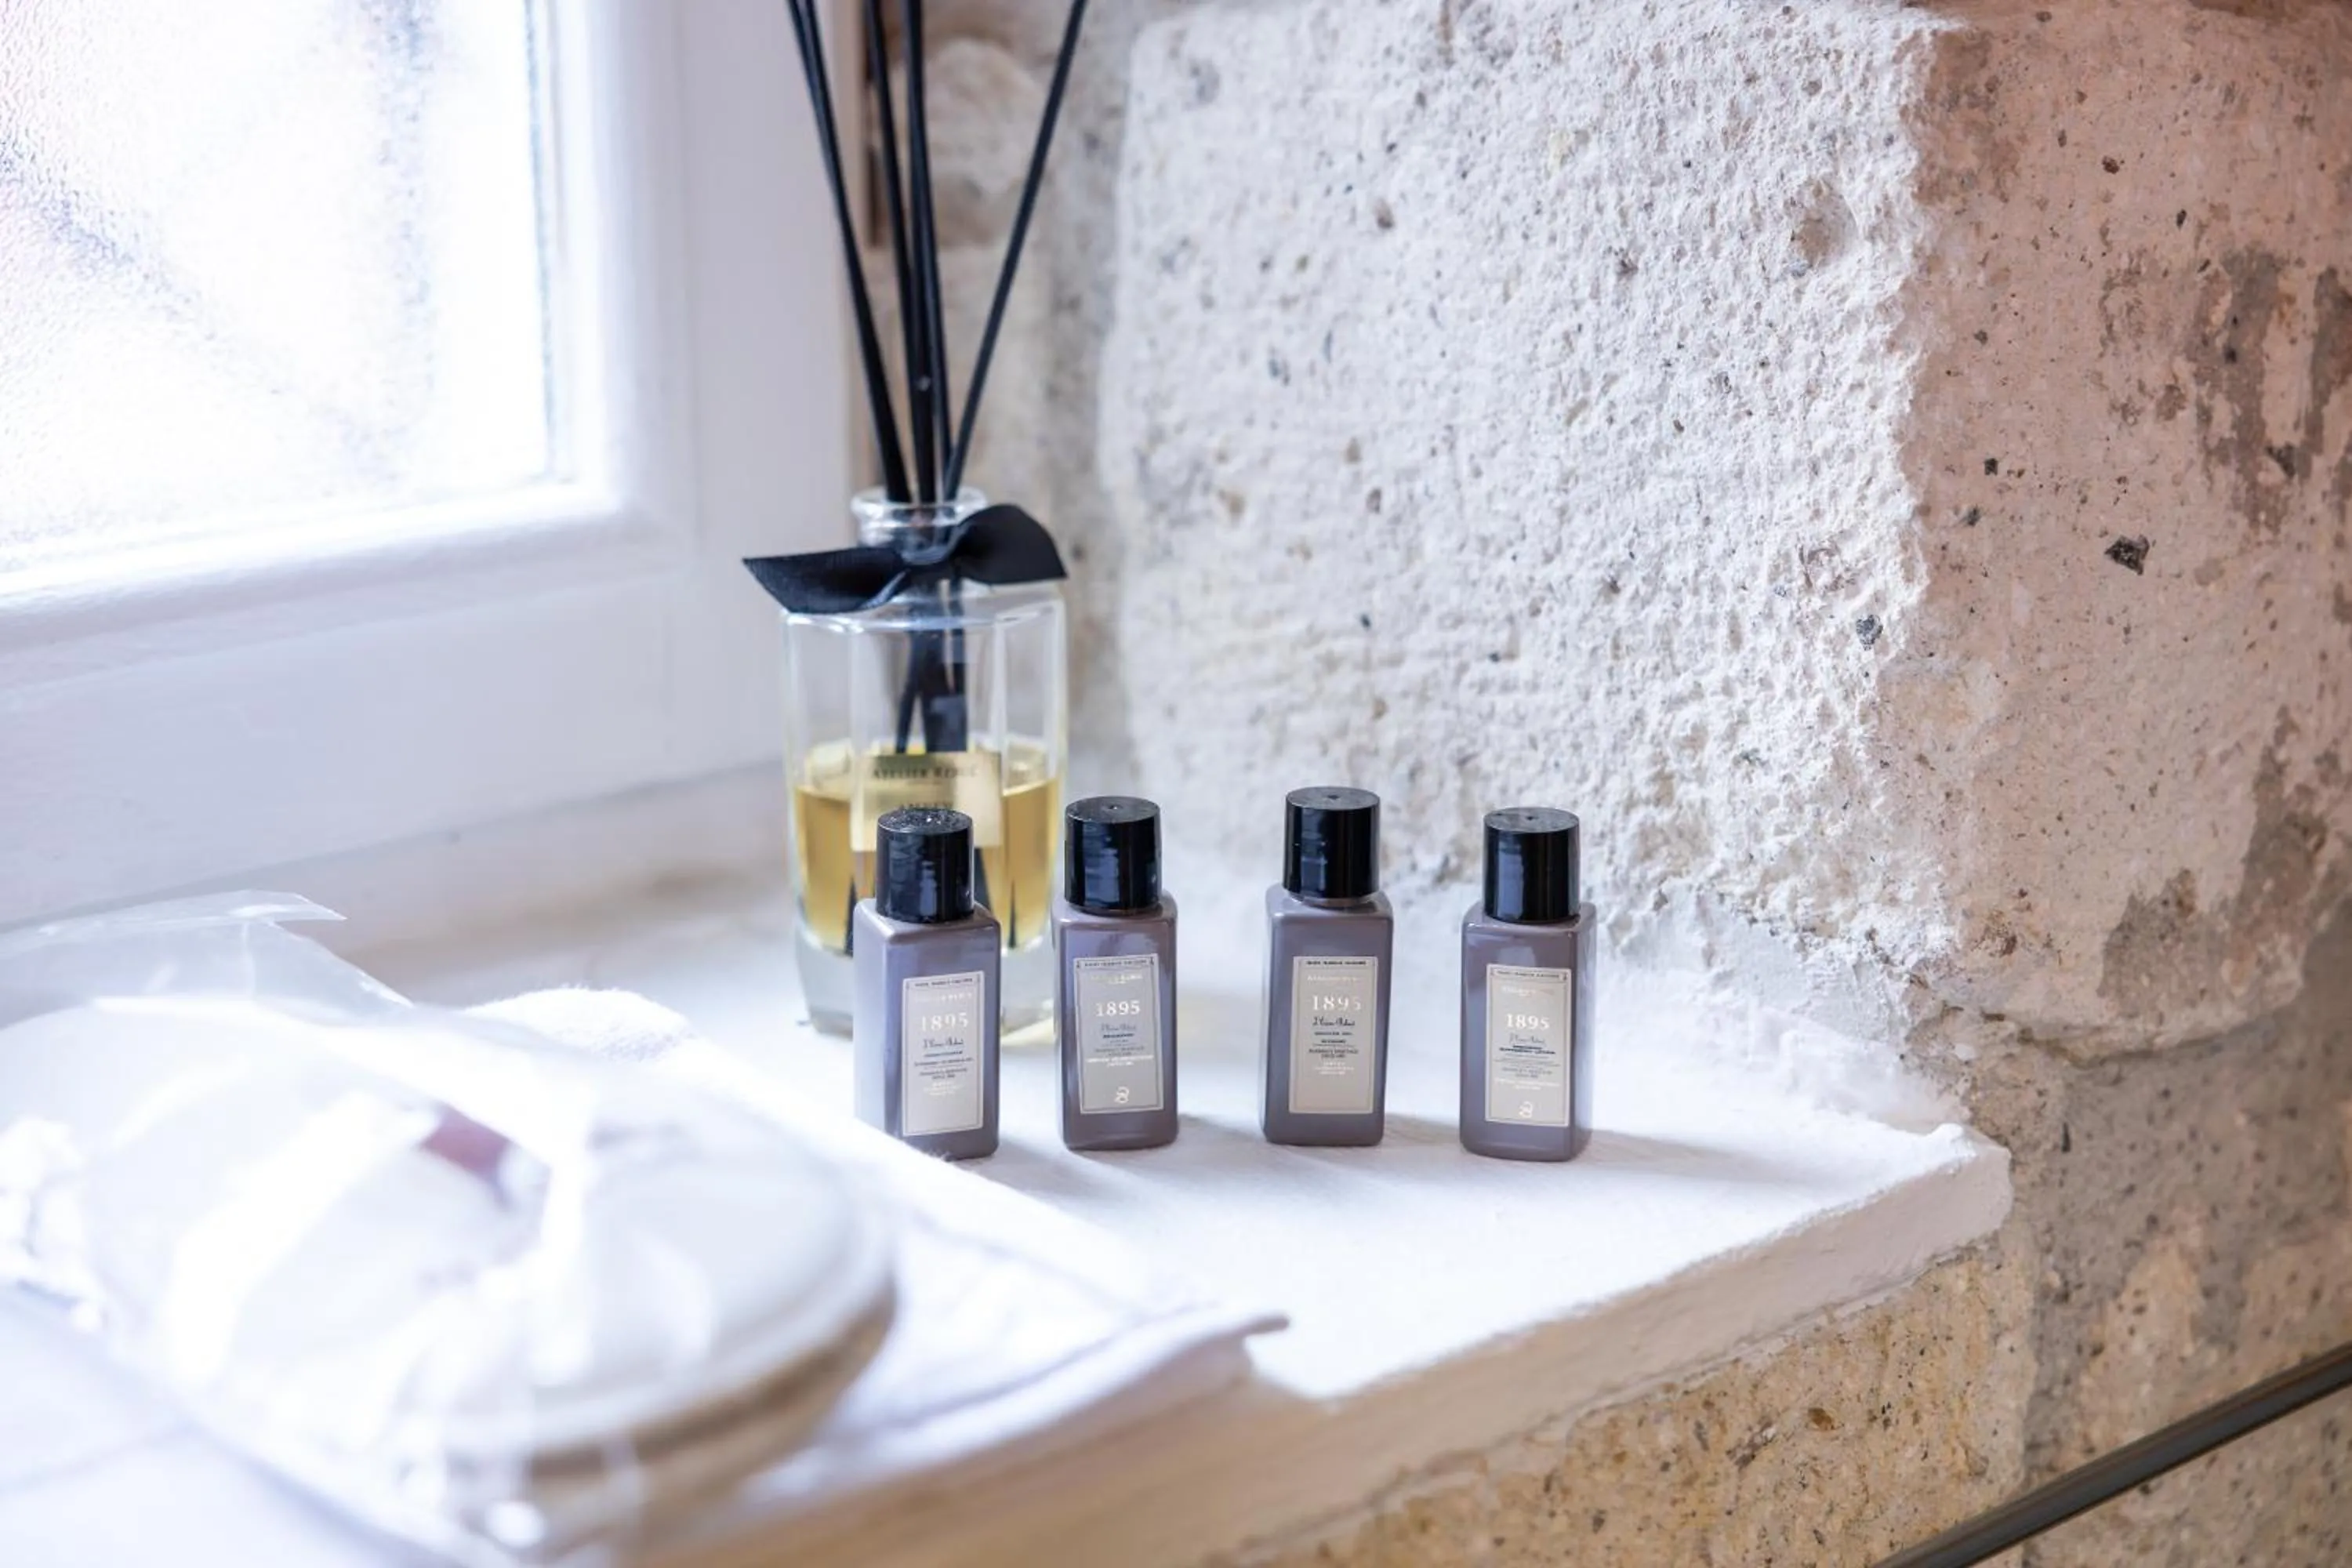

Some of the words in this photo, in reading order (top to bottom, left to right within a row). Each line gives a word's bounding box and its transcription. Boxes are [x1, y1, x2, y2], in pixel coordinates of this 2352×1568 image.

[1095, 1000, 1141, 1018] 1895
[1312, 995, 1361, 1011] 1895
[921, 1012, 969, 1032] 1895
[1506, 1013, 1550, 1031] 1895
